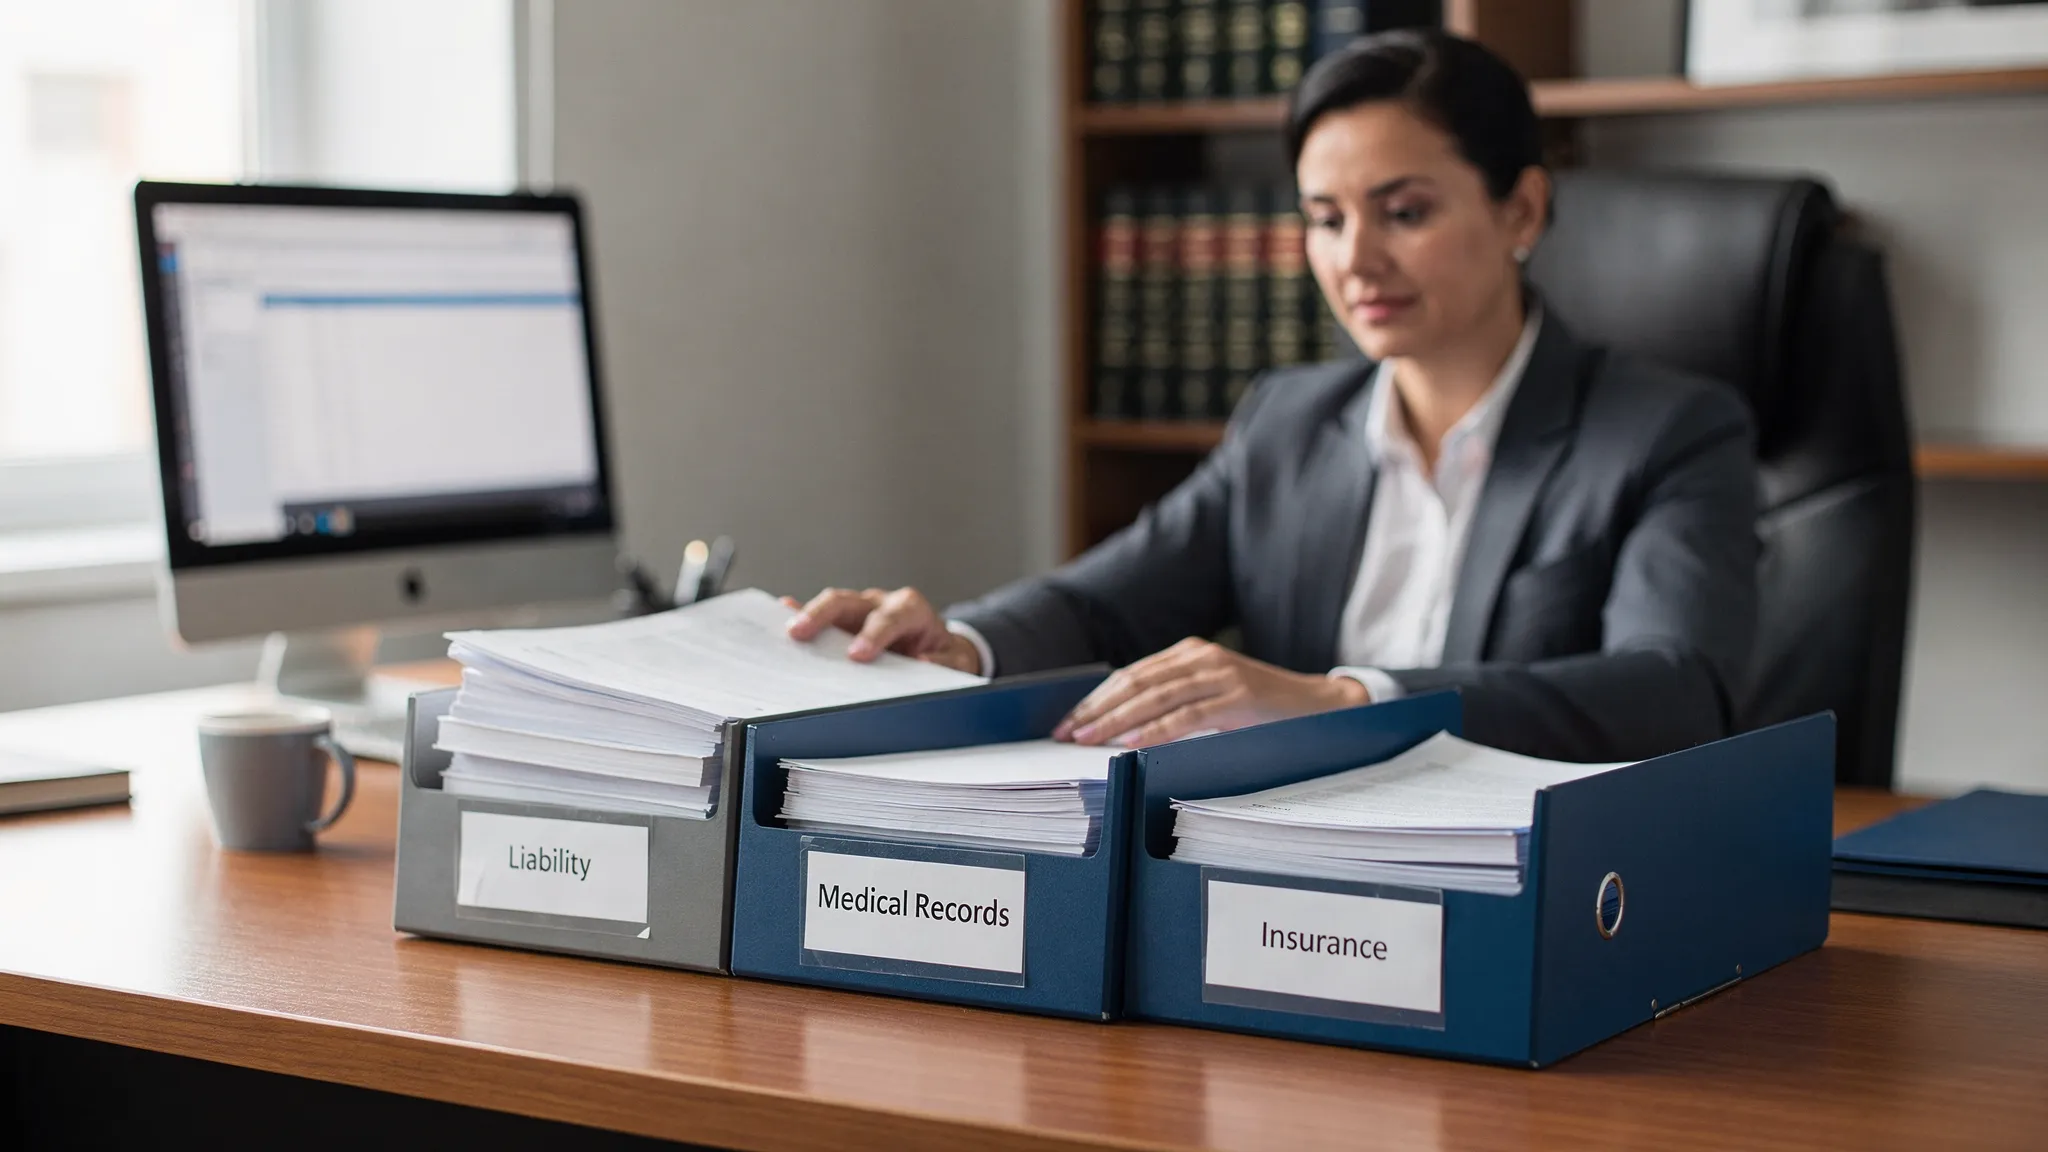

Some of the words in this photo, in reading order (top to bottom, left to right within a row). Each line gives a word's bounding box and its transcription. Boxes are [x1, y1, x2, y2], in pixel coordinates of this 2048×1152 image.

[508, 845, 592, 882] Liability
[817, 883, 908, 917] Medical
[914, 892, 1011, 928] Records
[1261, 920, 1389, 961] Insurance
